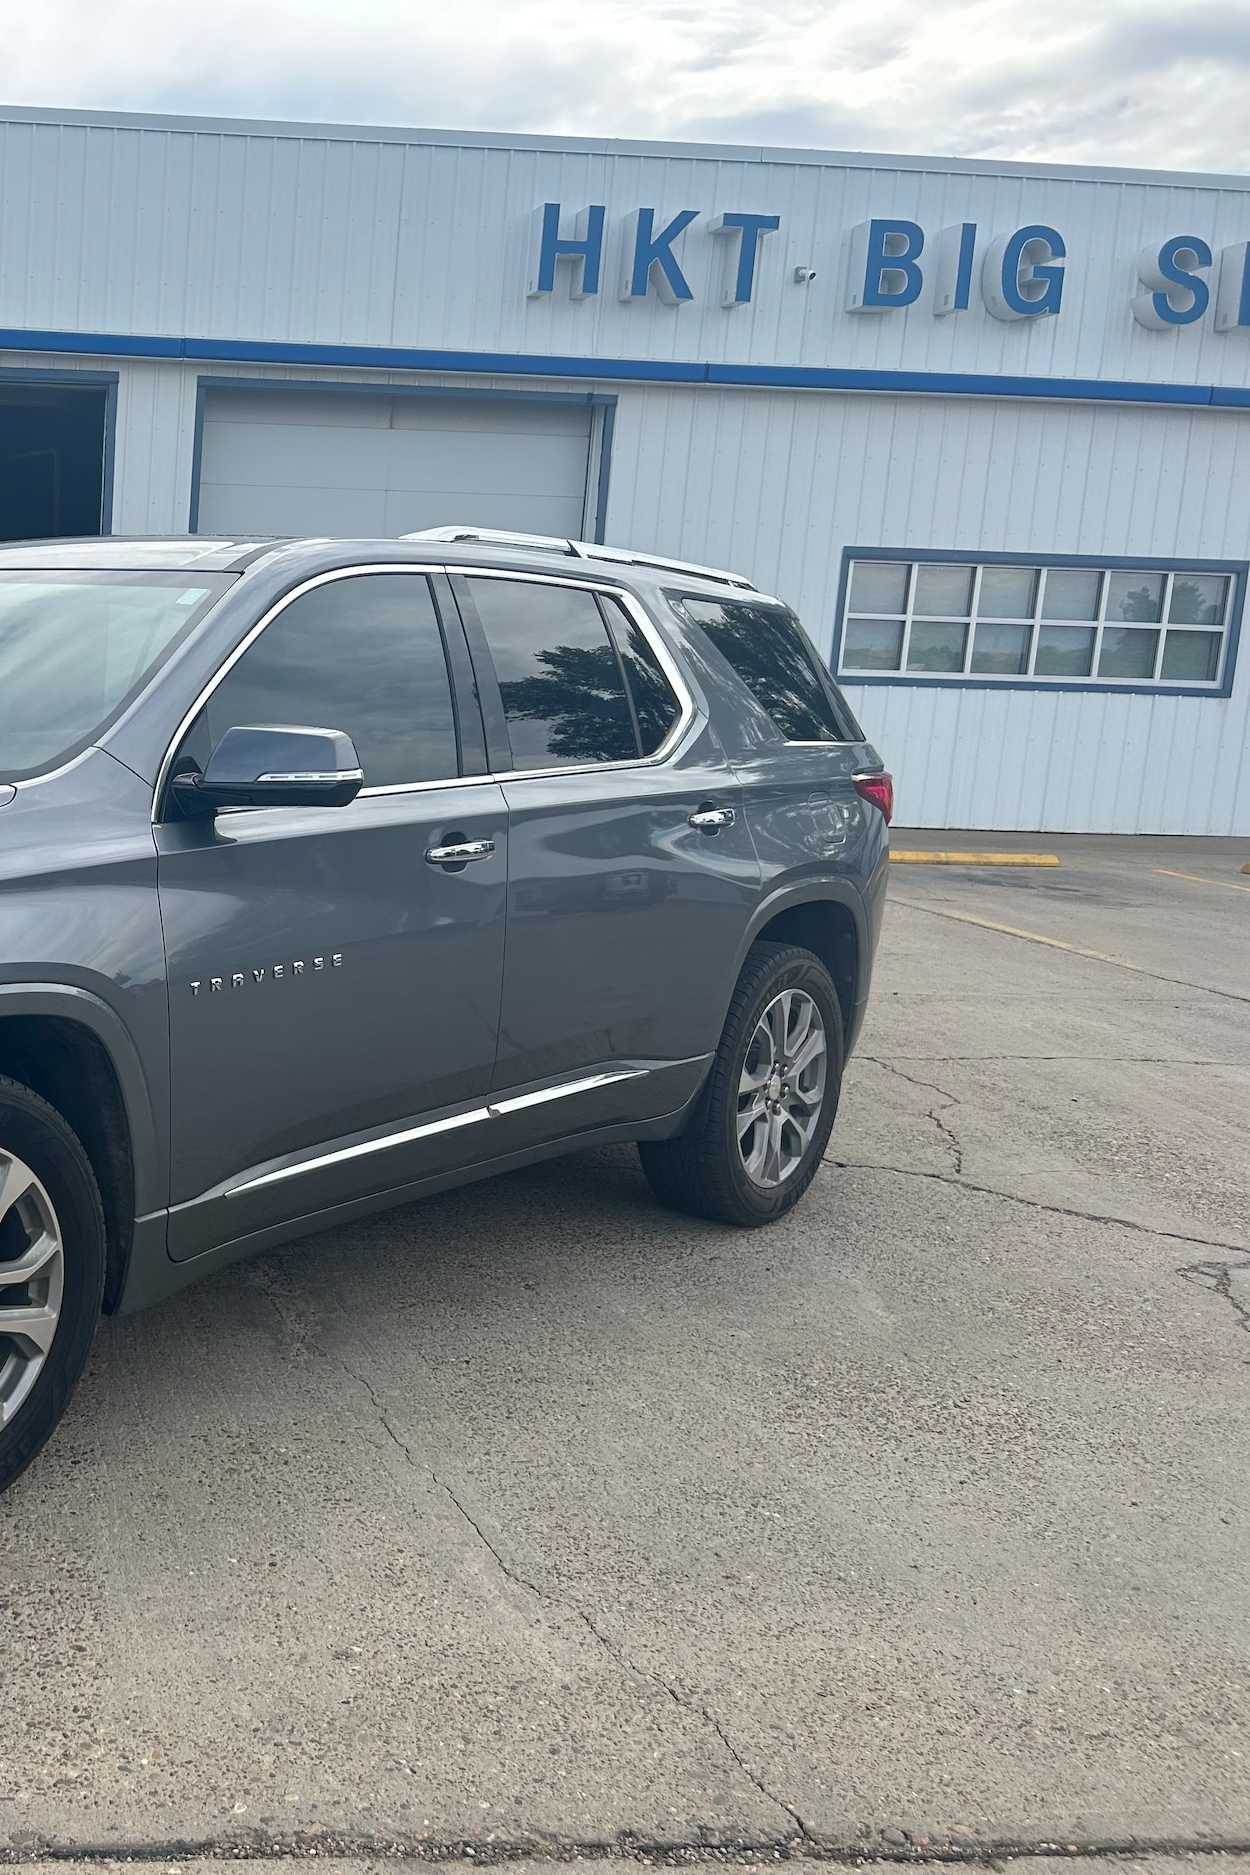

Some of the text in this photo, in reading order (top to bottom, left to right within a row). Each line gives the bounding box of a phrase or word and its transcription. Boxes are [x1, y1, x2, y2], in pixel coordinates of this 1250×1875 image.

[535, 202, 1250, 326] HKT BIG S
[190, 953, 343, 996] TRAVERSE
